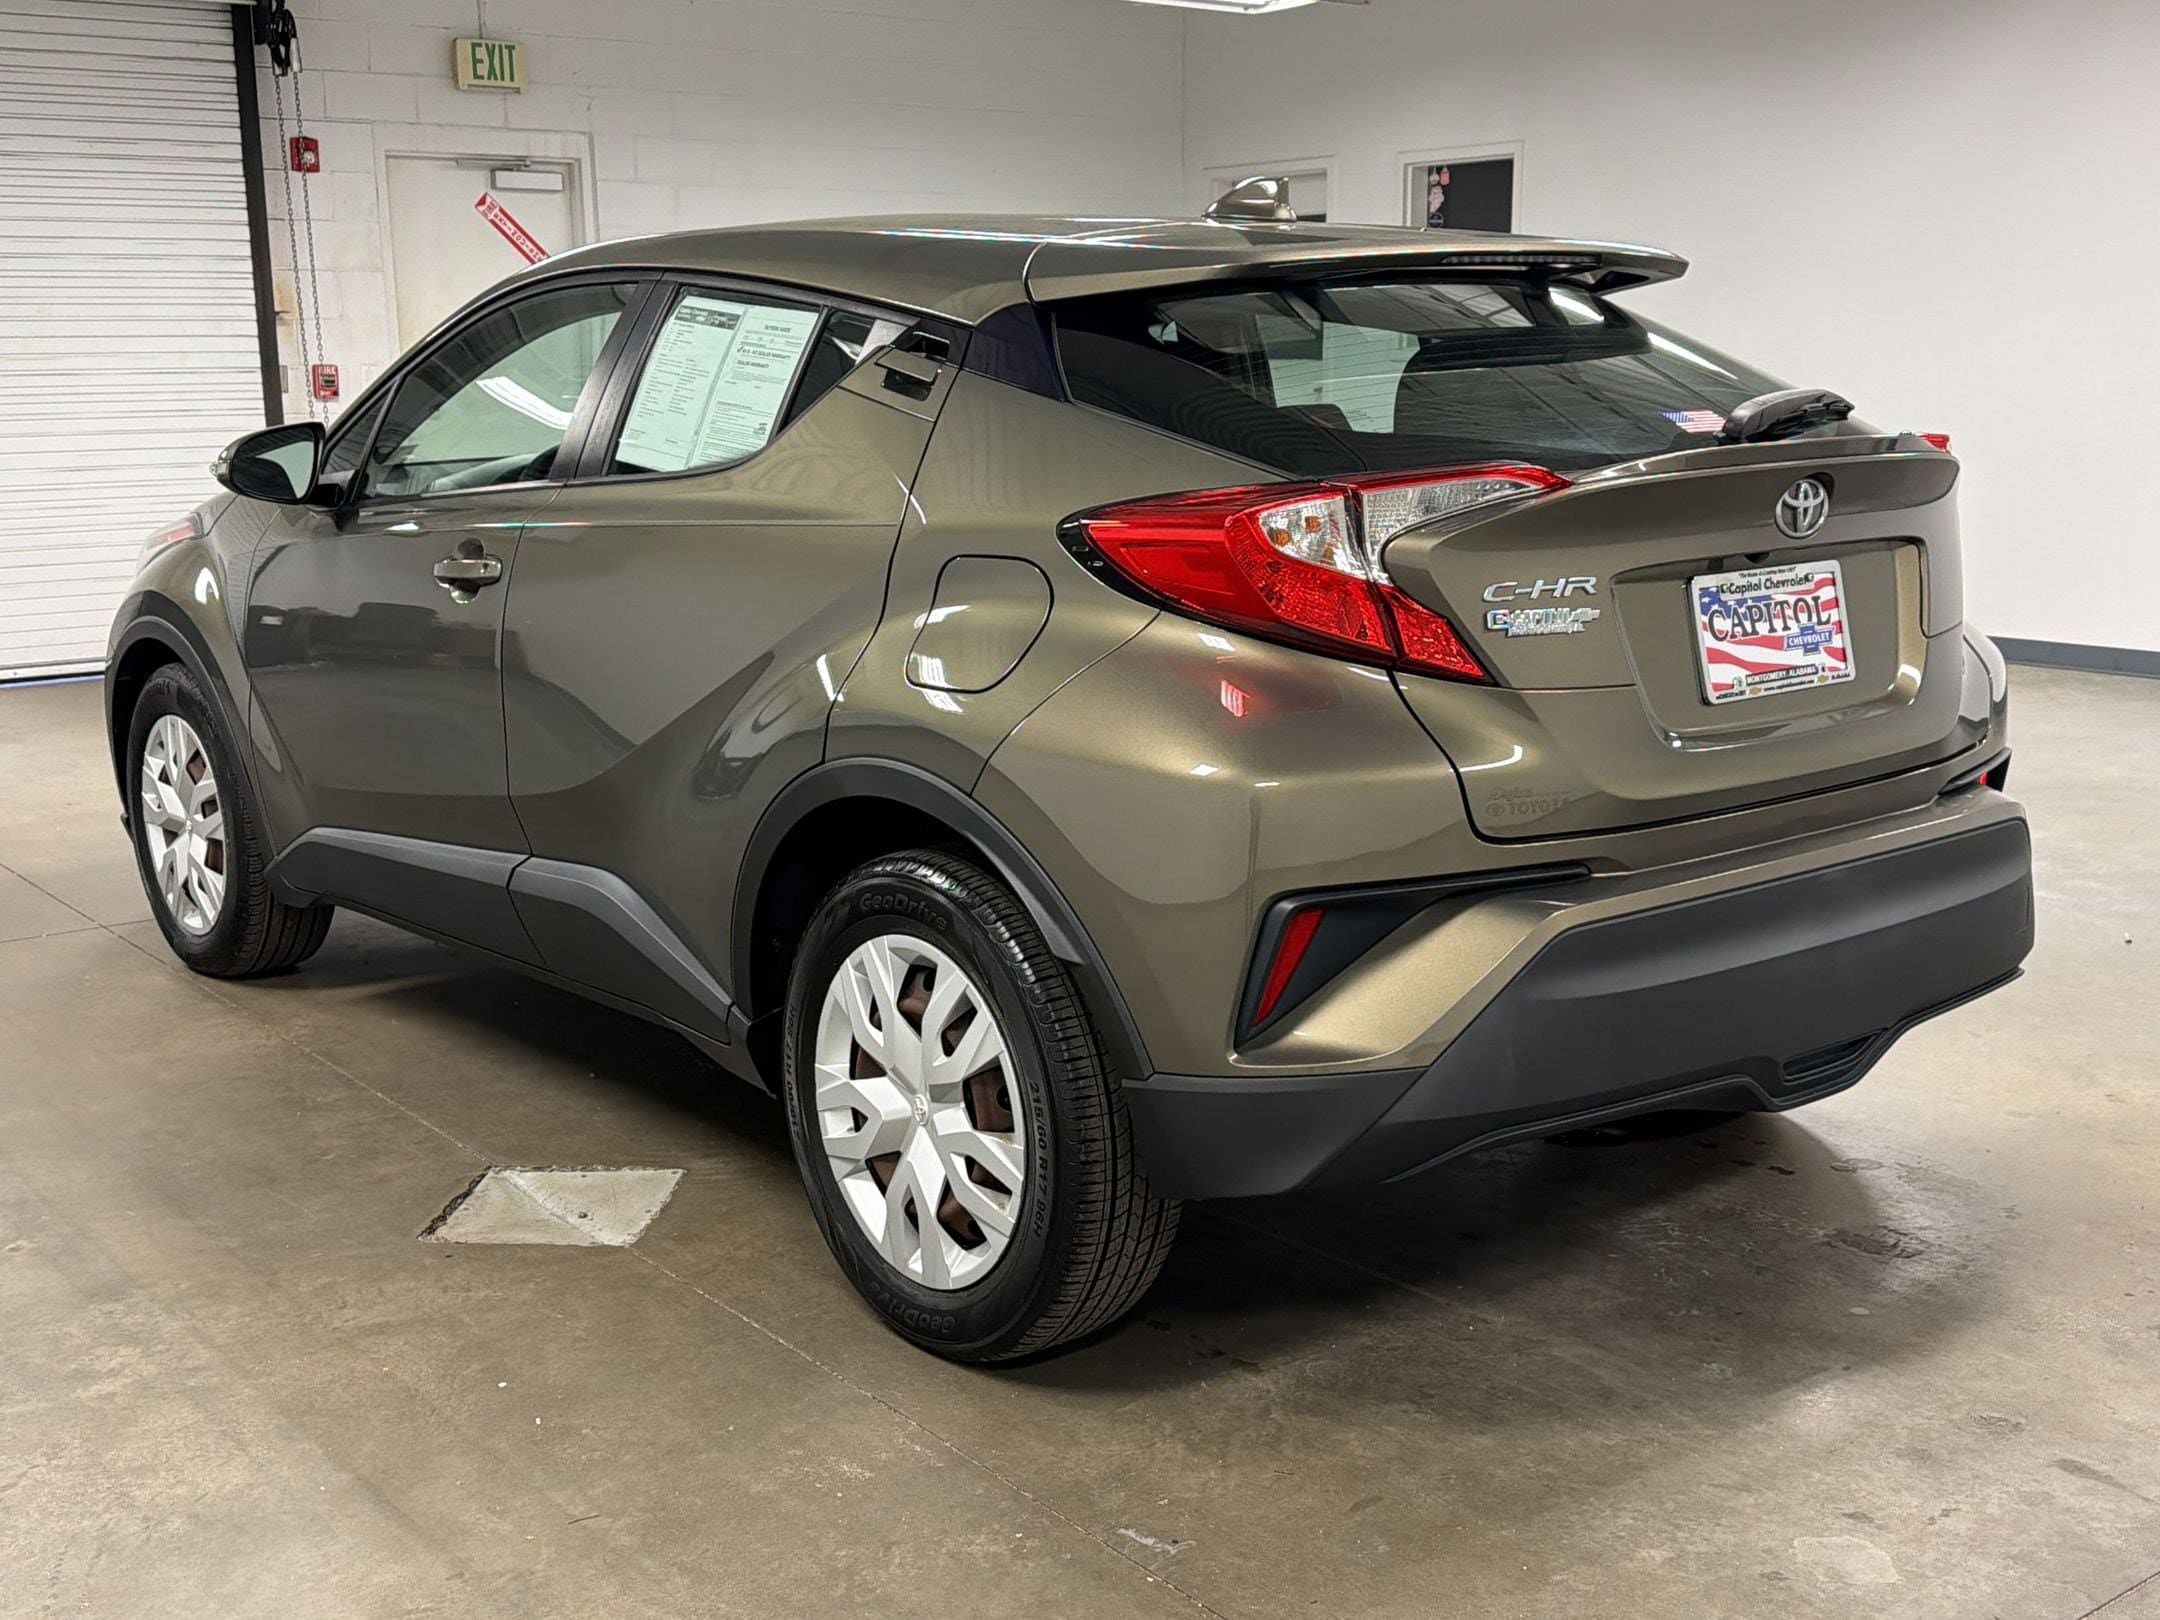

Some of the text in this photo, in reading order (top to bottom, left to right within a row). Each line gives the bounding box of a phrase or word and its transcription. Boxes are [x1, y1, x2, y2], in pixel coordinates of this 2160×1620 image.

[471, 42, 516, 82] EXIT
[1483, 576, 1598, 602] C-HR
[1729, 576, 1762, 596] Capitol
[1708, 595, 1831, 642] CAPITOL
[1788, 632, 1830, 646] CHEVROLET
[1789, 666, 1818, 679] ALABAMA
[1029, 1081, 1047, 1150] 215/60
[1038, 1156, 1049, 1198] R17
